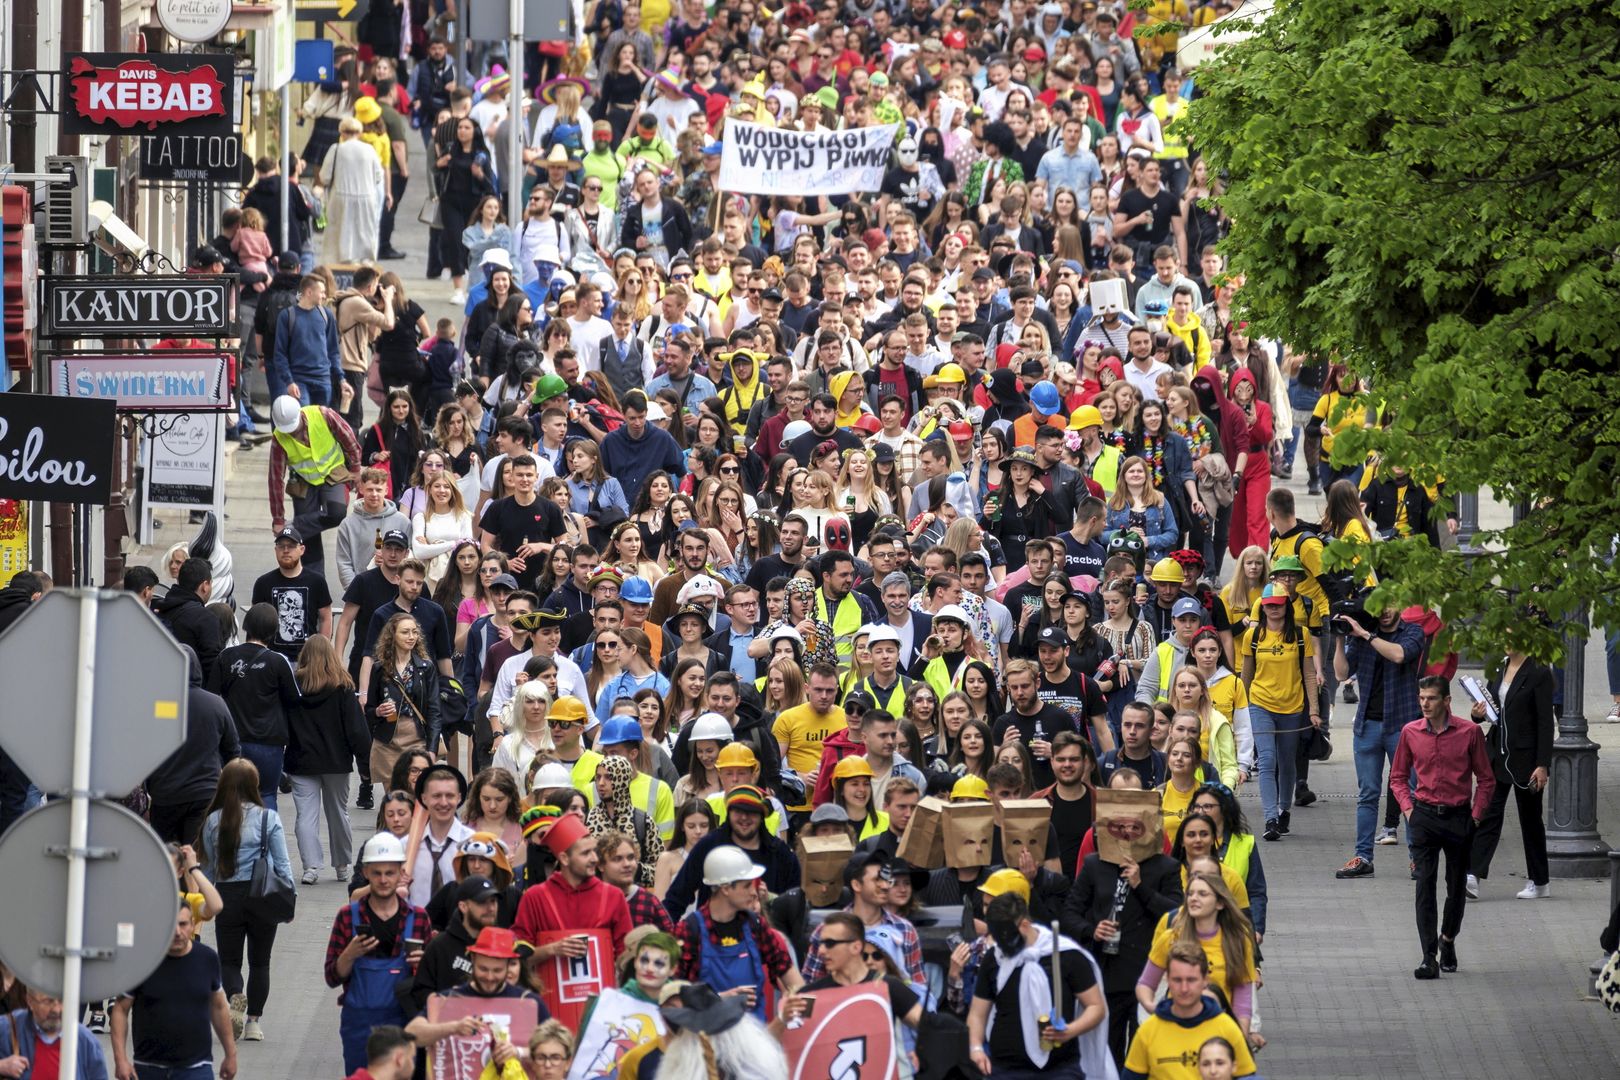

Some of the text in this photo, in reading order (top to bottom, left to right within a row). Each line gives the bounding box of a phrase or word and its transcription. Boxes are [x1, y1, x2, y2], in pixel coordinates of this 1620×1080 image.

[119, 69, 157, 80] DAVIS
[89, 82, 213, 111] KEBAB
[144, 135, 238, 168] TATTOO
[739, 147, 814, 170] WYPIJ
[59, 289, 220, 324] KANTOR
[75, 367, 206, 397] ŚWIDERKI
[0, 416, 97, 486] ilou
[1065, 554, 1102, 566] Reebok
